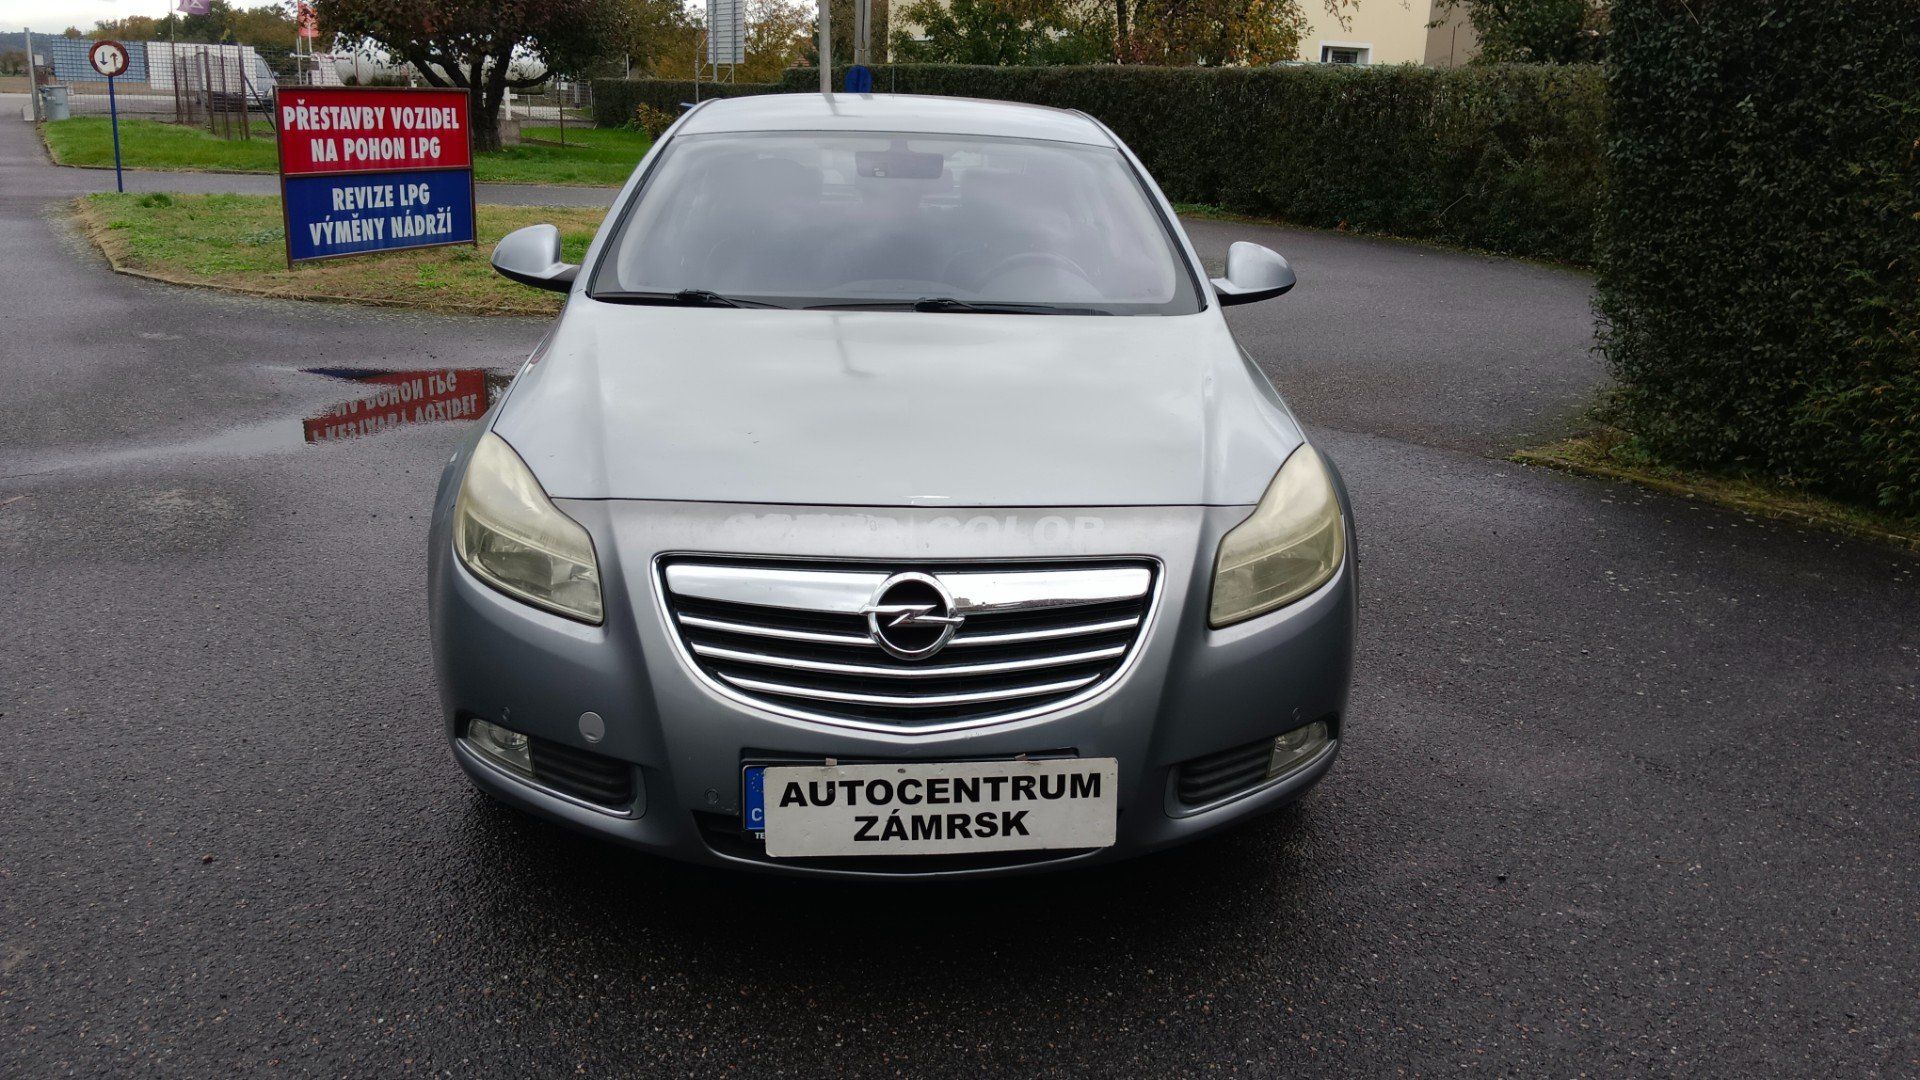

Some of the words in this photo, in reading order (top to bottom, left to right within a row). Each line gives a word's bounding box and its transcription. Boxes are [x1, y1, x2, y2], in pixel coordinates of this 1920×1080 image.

[283, 99, 385, 130] PŘESTAVBY
[390, 107, 460, 130] VOZIDEL
[310, 138, 338, 162] NA
[343, 137, 406, 161] POHON
[411, 136, 441, 159] LPG
[332, 185, 394, 211] REVIZE
[400, 183, 430, 206] LPG
[309, 212, 385, 246] VÝMĚNY
[391, 206, 452, 239] NÁDRŽÍ
[779, 773, 1102, 808] AUTOCENTRUM
[853, 809, 1030, 842] ZÁMRSK
